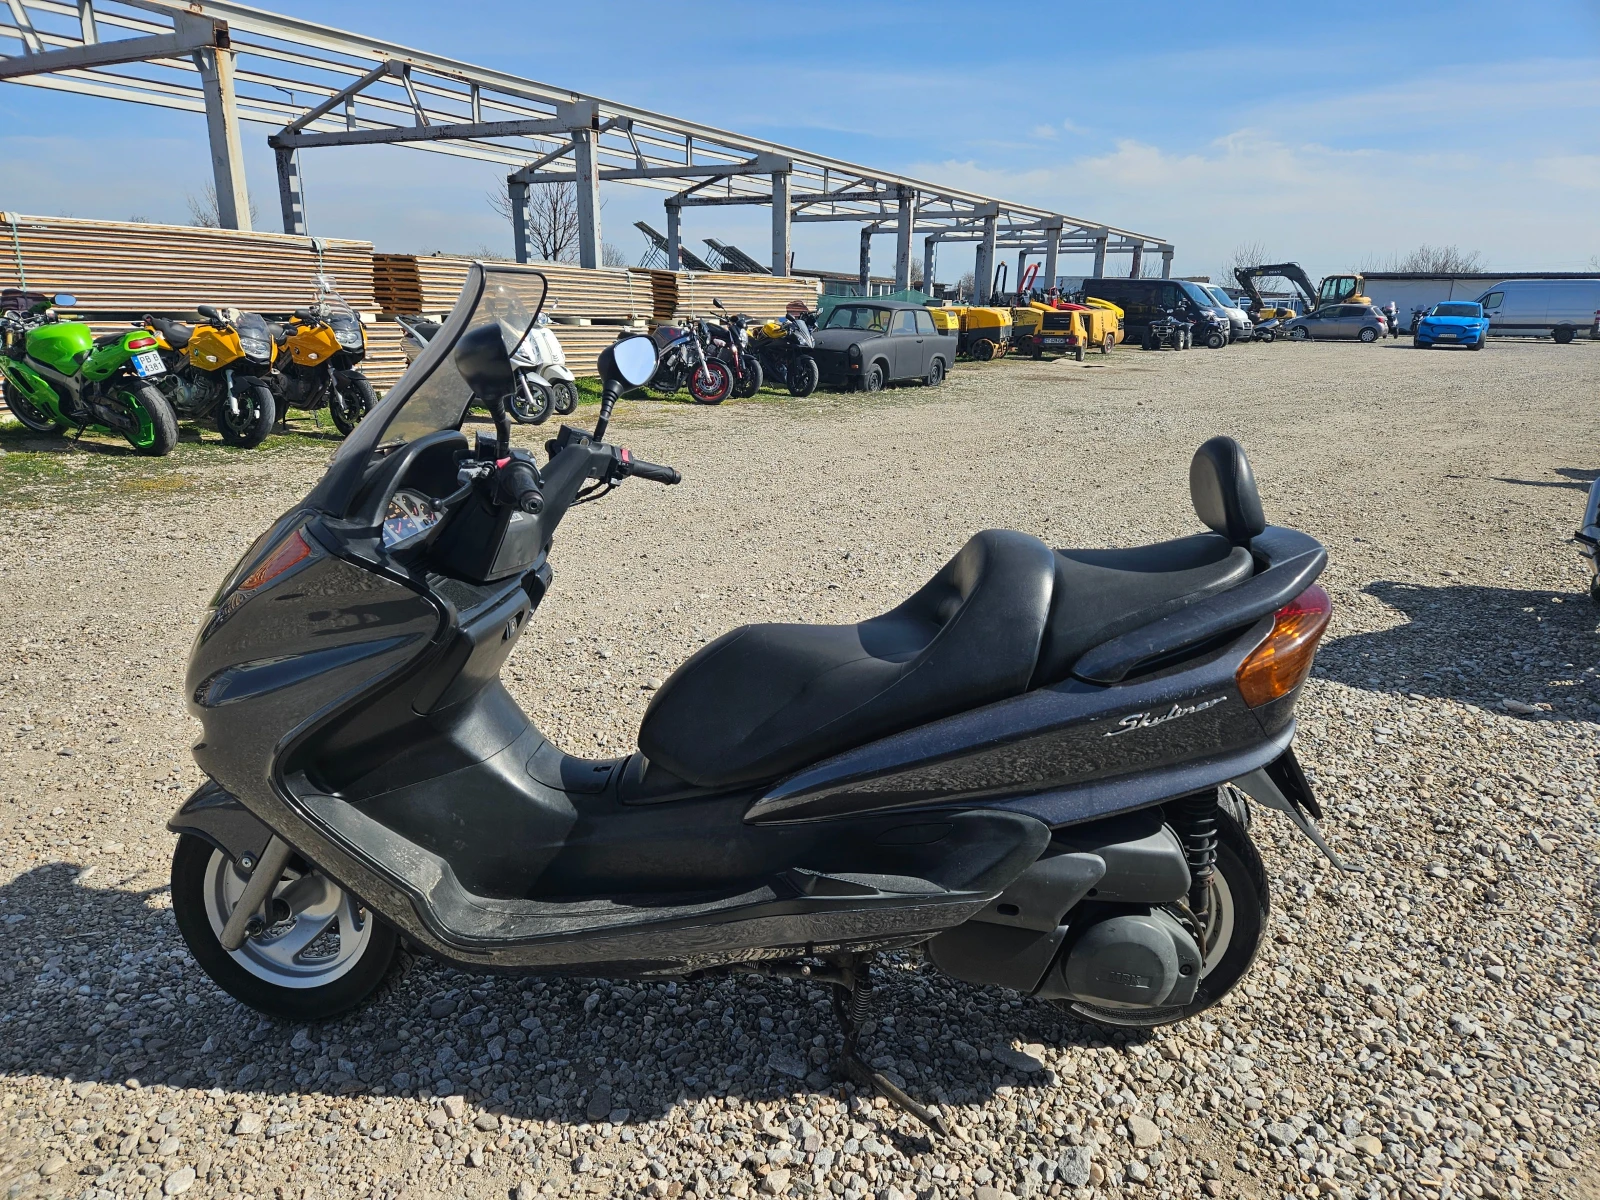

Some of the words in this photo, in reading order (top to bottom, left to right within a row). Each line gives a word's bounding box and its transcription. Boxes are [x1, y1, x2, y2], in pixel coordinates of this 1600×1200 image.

[140, 355, 152, 364] PB
[152, 353, 159, 361] B
[1102, 696, 1228, 737] Skyliner
